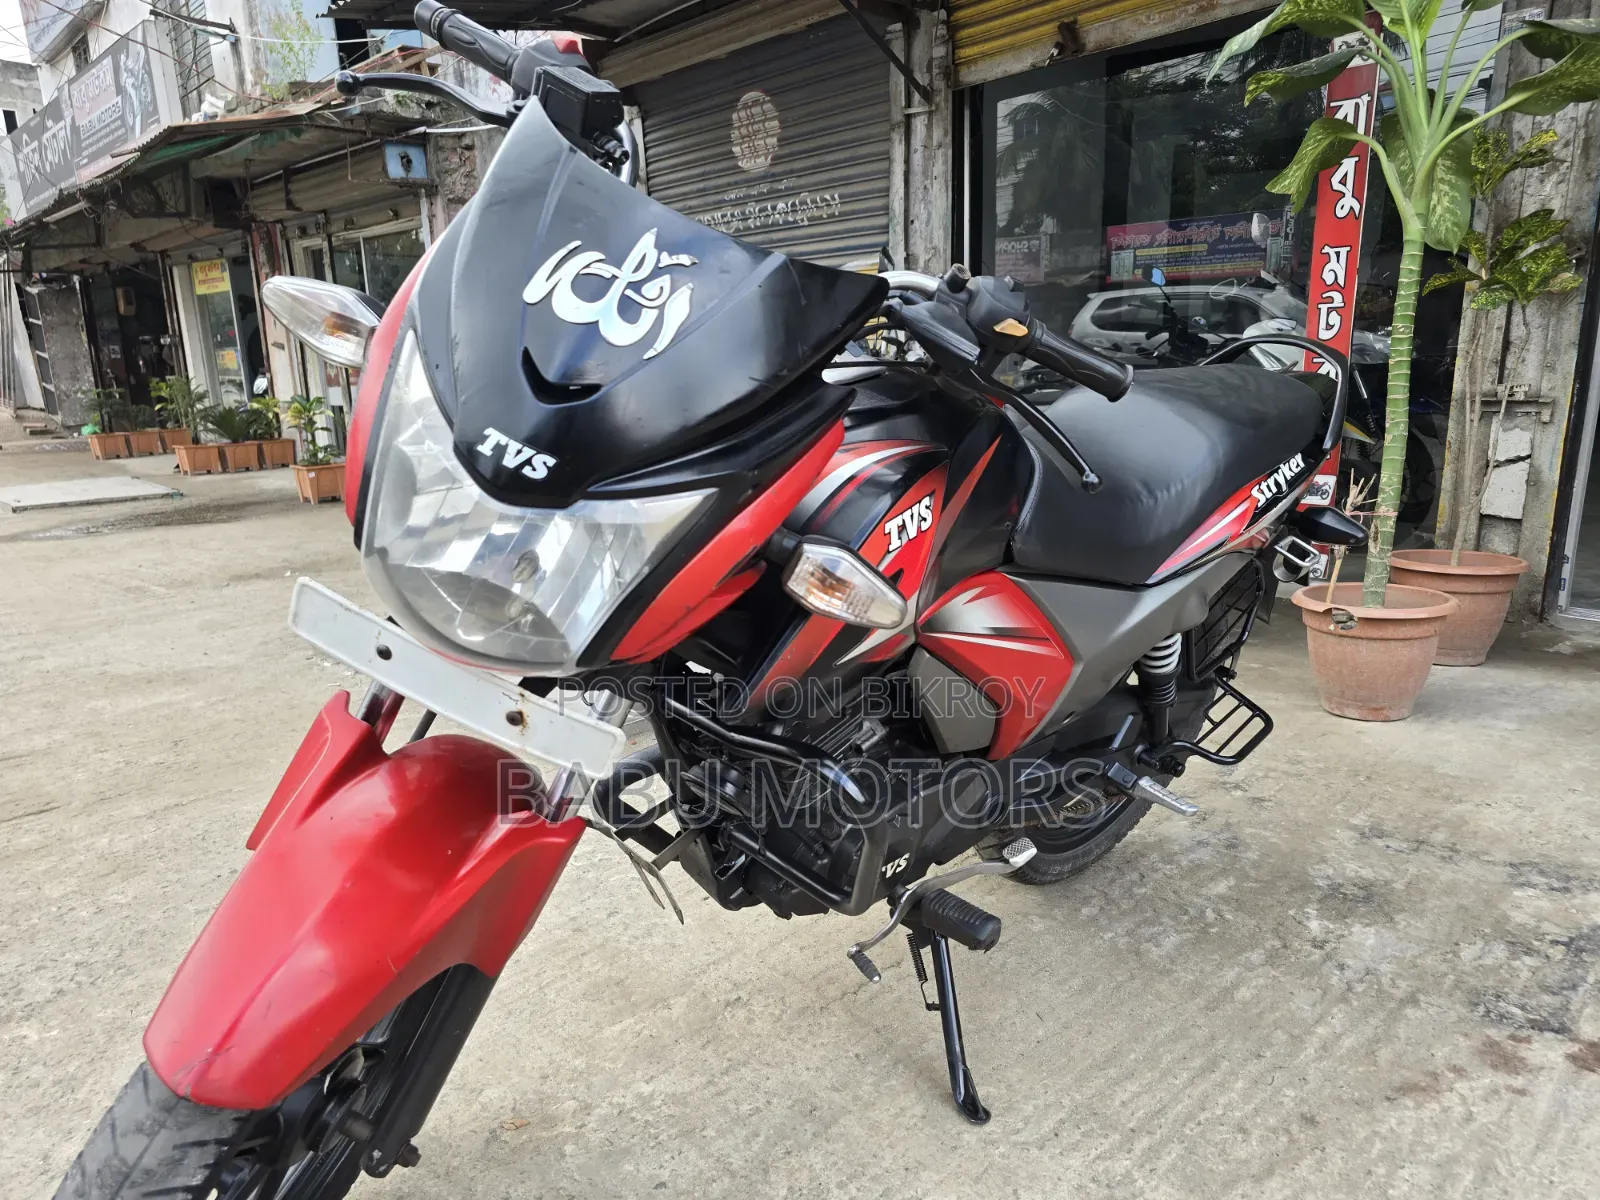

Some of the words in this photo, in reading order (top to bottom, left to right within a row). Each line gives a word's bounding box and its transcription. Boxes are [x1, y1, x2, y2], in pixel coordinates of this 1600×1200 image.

[476, 426, 557, 480] TVS
[1250, 452, 1306, 508] Stryker
[884, 496, 933, 553] TVS
[881, 852, 911, 879] VS
